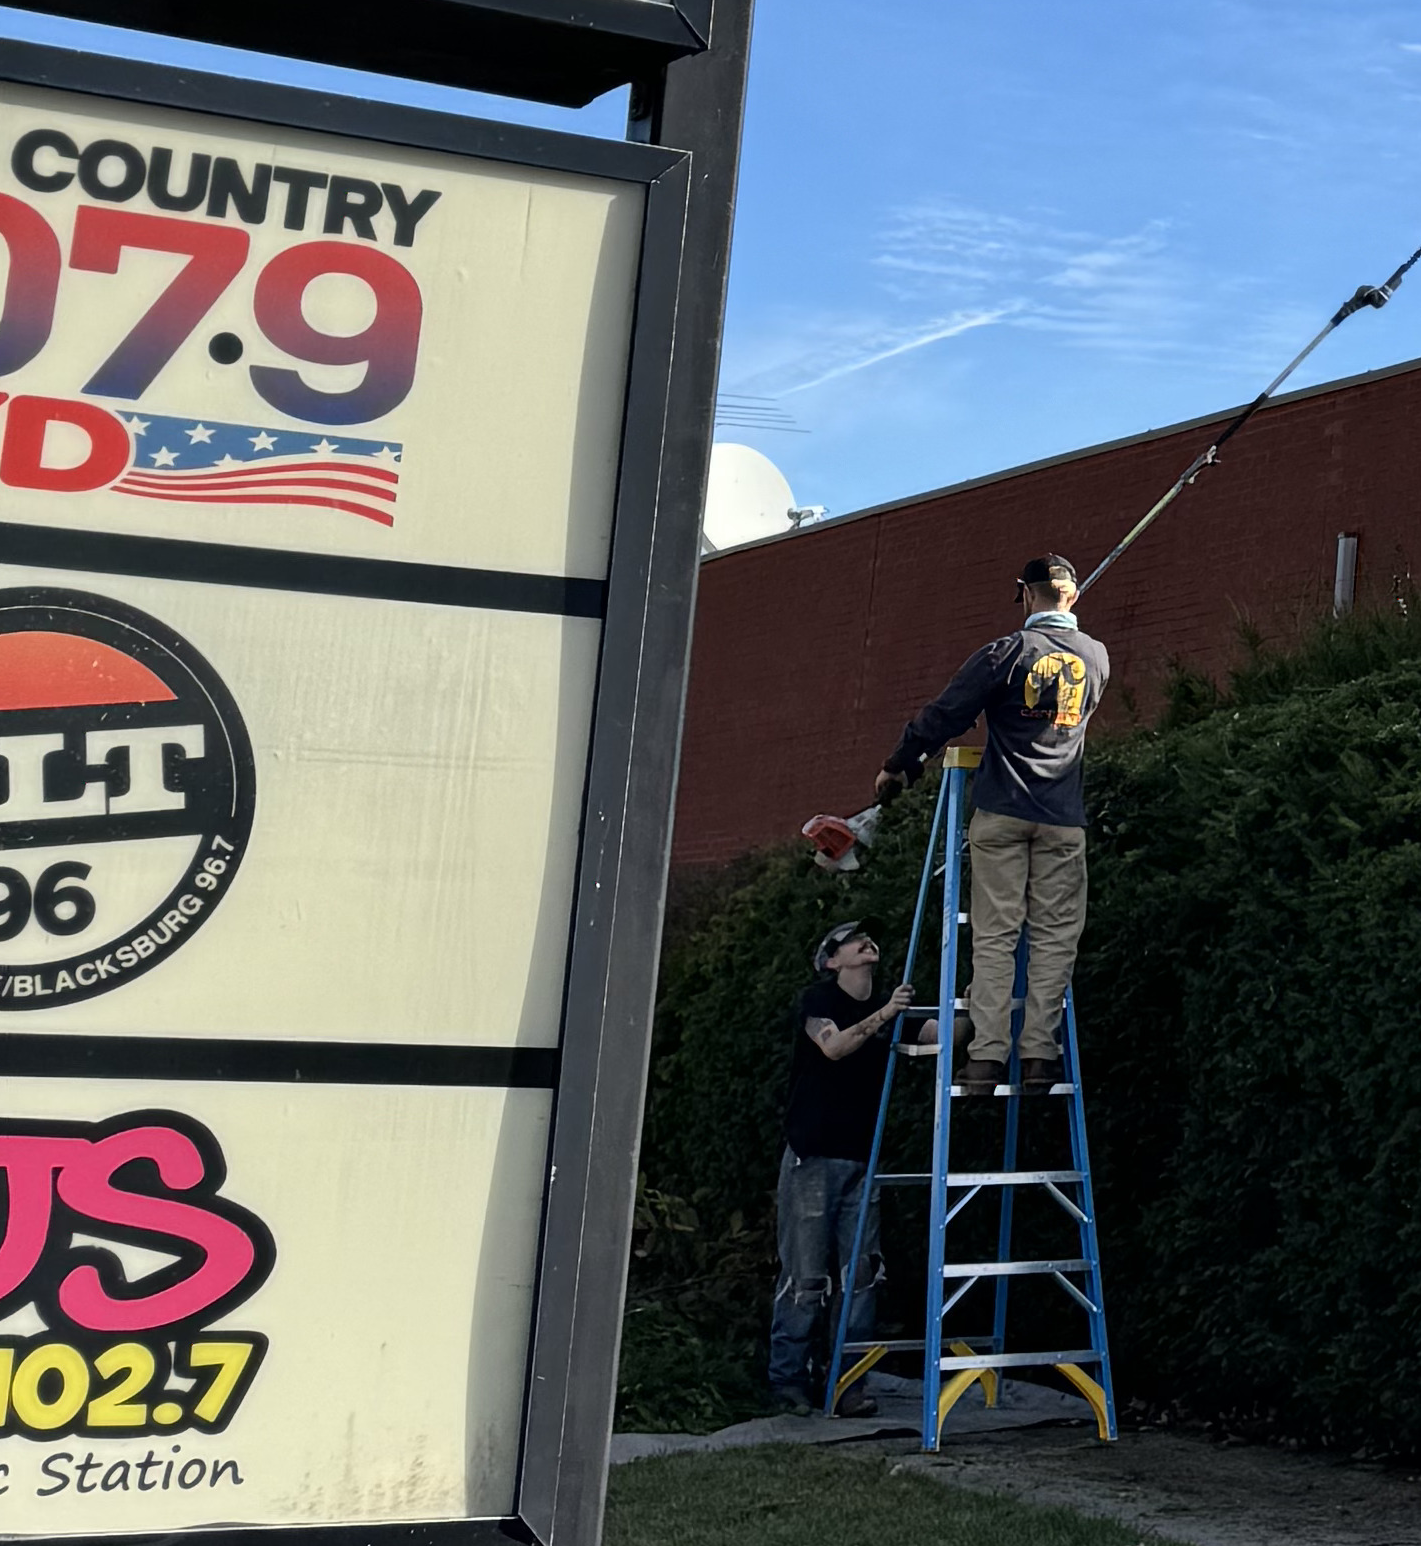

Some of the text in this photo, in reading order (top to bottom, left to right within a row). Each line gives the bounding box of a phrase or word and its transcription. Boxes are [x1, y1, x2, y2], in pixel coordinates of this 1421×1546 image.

[11, 129, 442, 247] COUNTRY
[0, 391, 130, 492] D
[0, 835, 235, 997] /BLACKSBURG 96.7
[37, 1445, 244, 1496] Station
